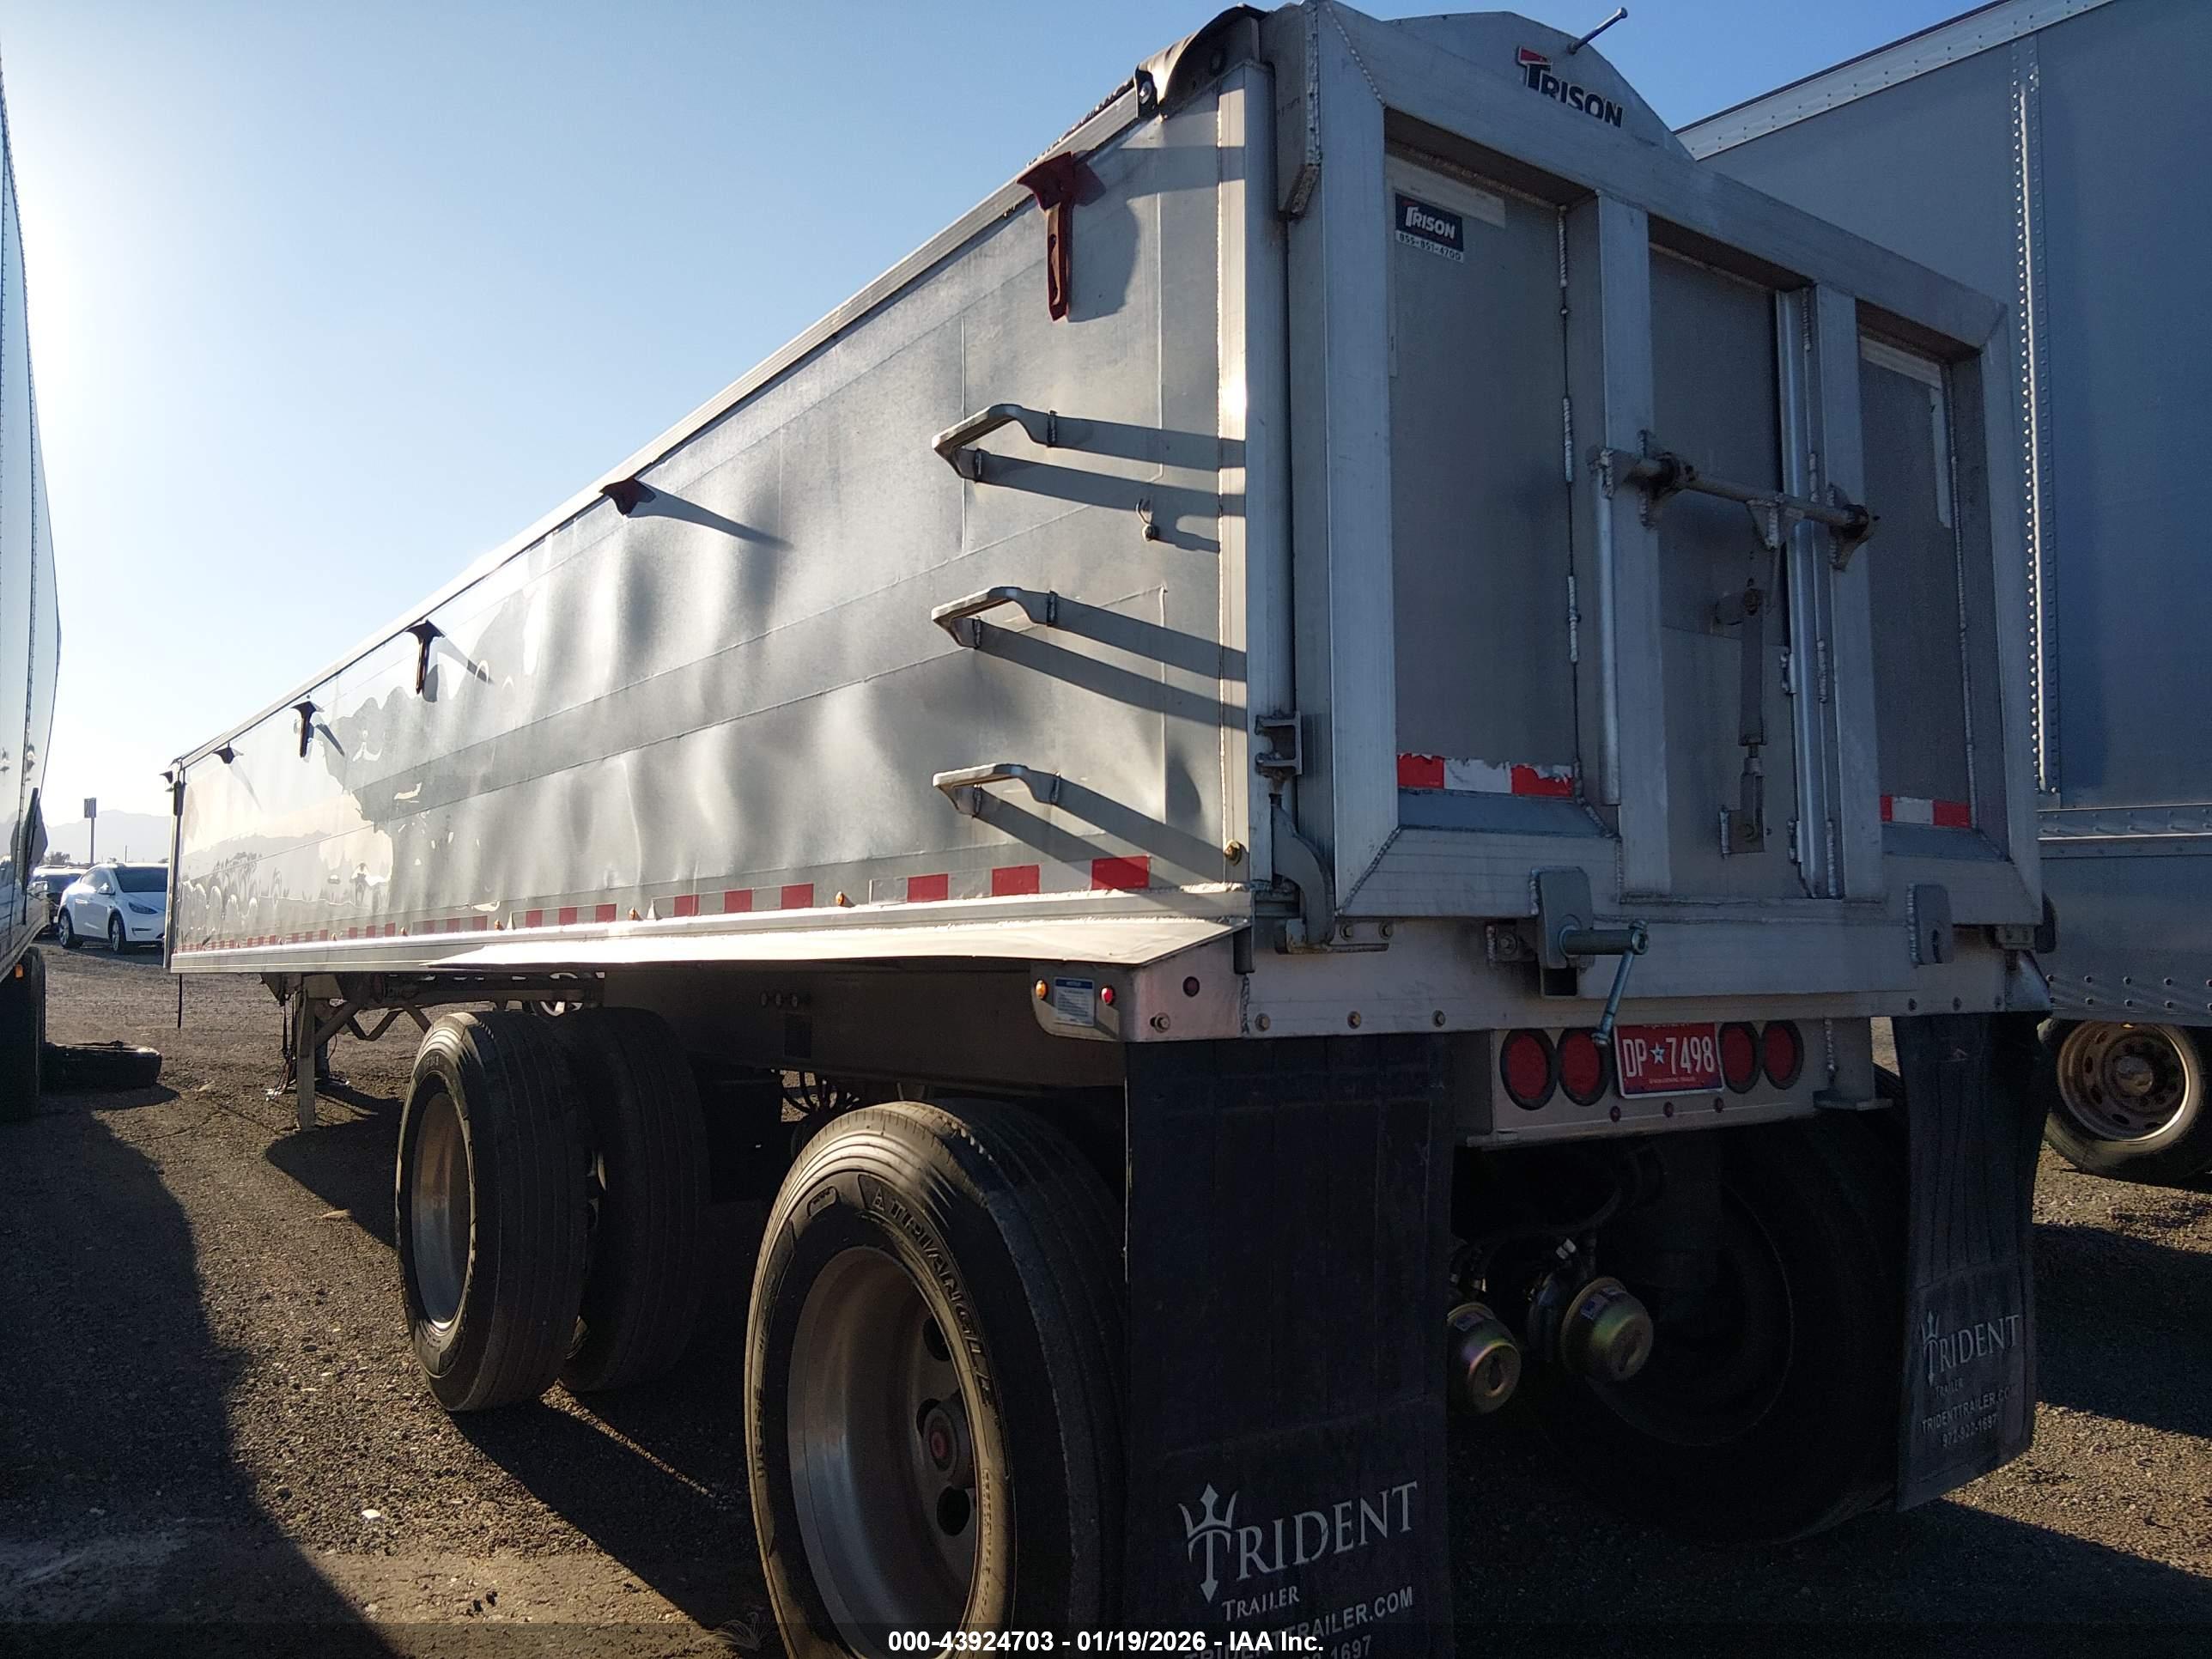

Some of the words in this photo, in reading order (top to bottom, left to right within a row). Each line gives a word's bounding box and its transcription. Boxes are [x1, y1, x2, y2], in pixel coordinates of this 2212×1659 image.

[1516, 45, 1624, 128] TRISON
[1405, 205, 1455, 240] TRISON
[1622, 1038, 1648, 1078] DP
[1665, 1036, 1716, 1075] 7498
[1921, 1310, 2020, 1389] TRIDENT
[1922, 1387, 2014, 1434] TRIDENTTRAILER.CO
[1178, 1481, 1419, 1603] TRIDENT
[1221, 1585, 1300, 1621] TRAILER
